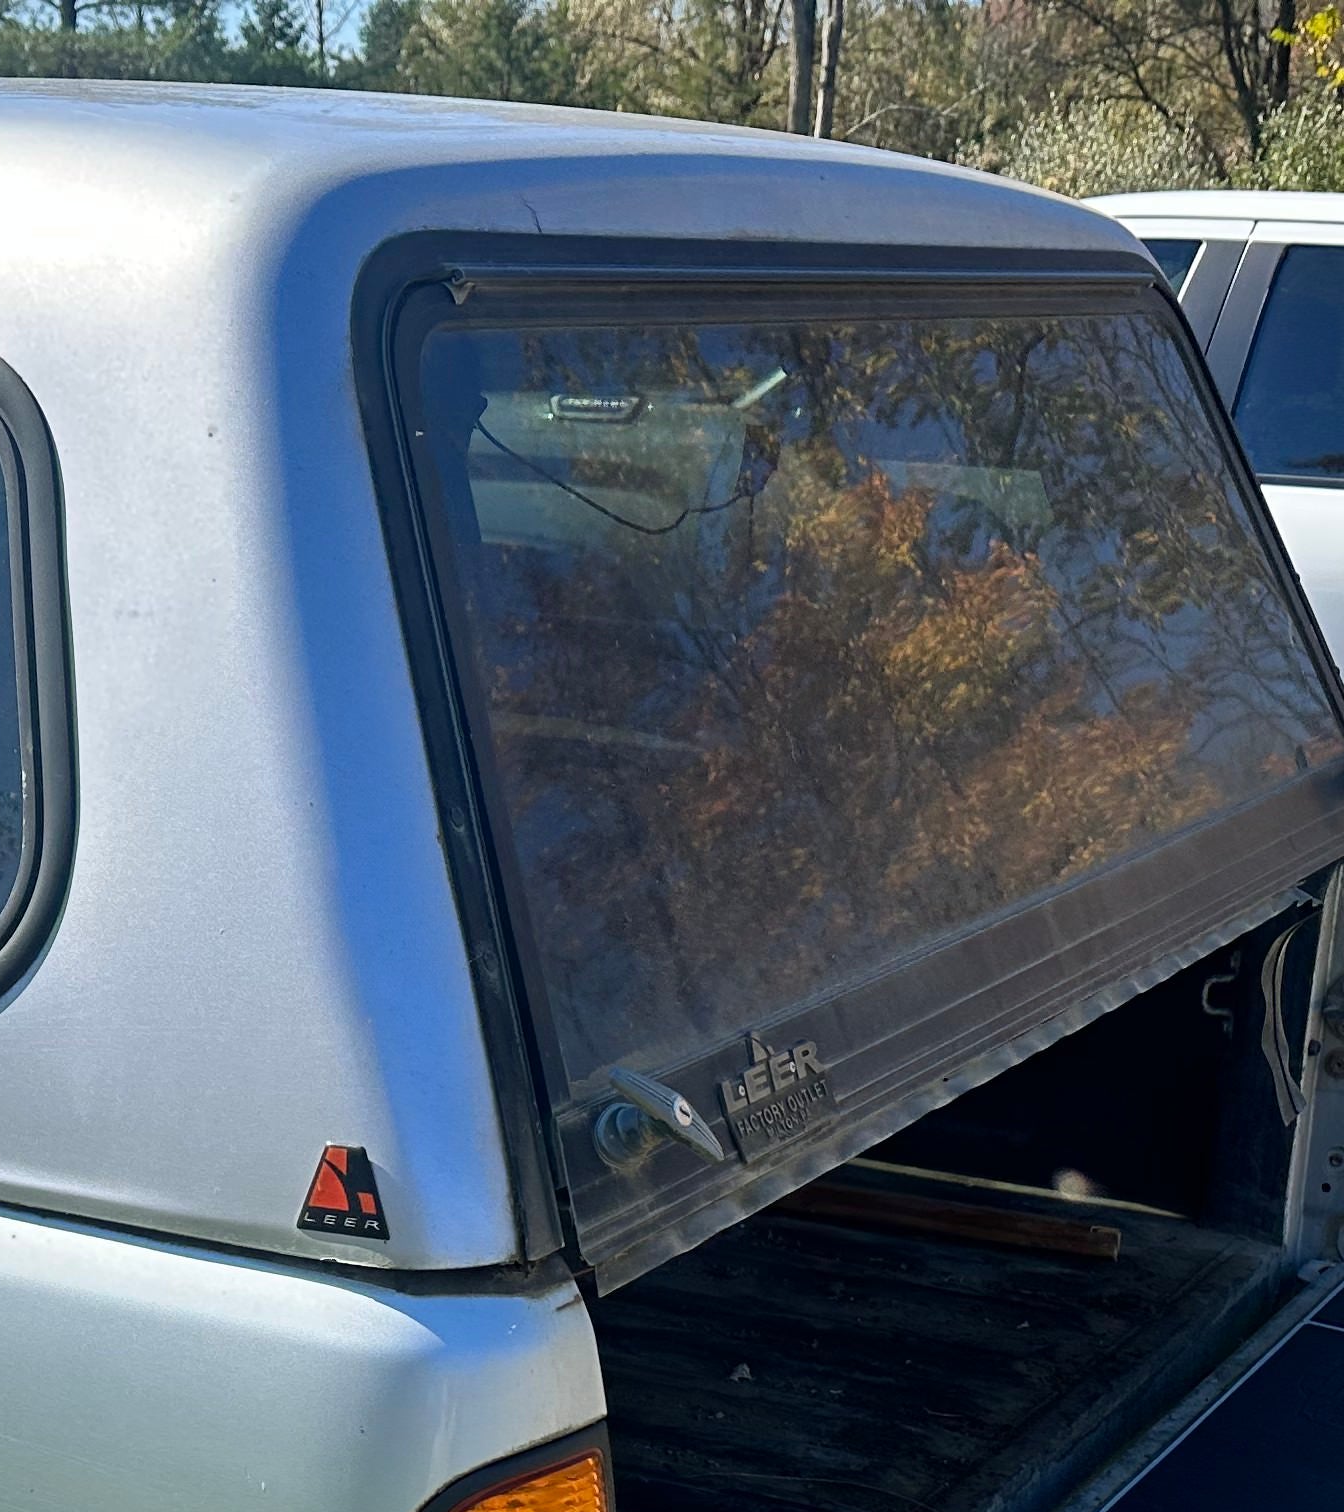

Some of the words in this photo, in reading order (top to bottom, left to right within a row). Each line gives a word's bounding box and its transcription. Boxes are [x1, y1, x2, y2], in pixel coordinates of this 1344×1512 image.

[721, 1040, 826, 1112] LEER
[736, 1100, 786, 1138] FACTORY
[787, 1080, 829, 1111] OUTLET
[303, 1211, 381, 1231] LEER
